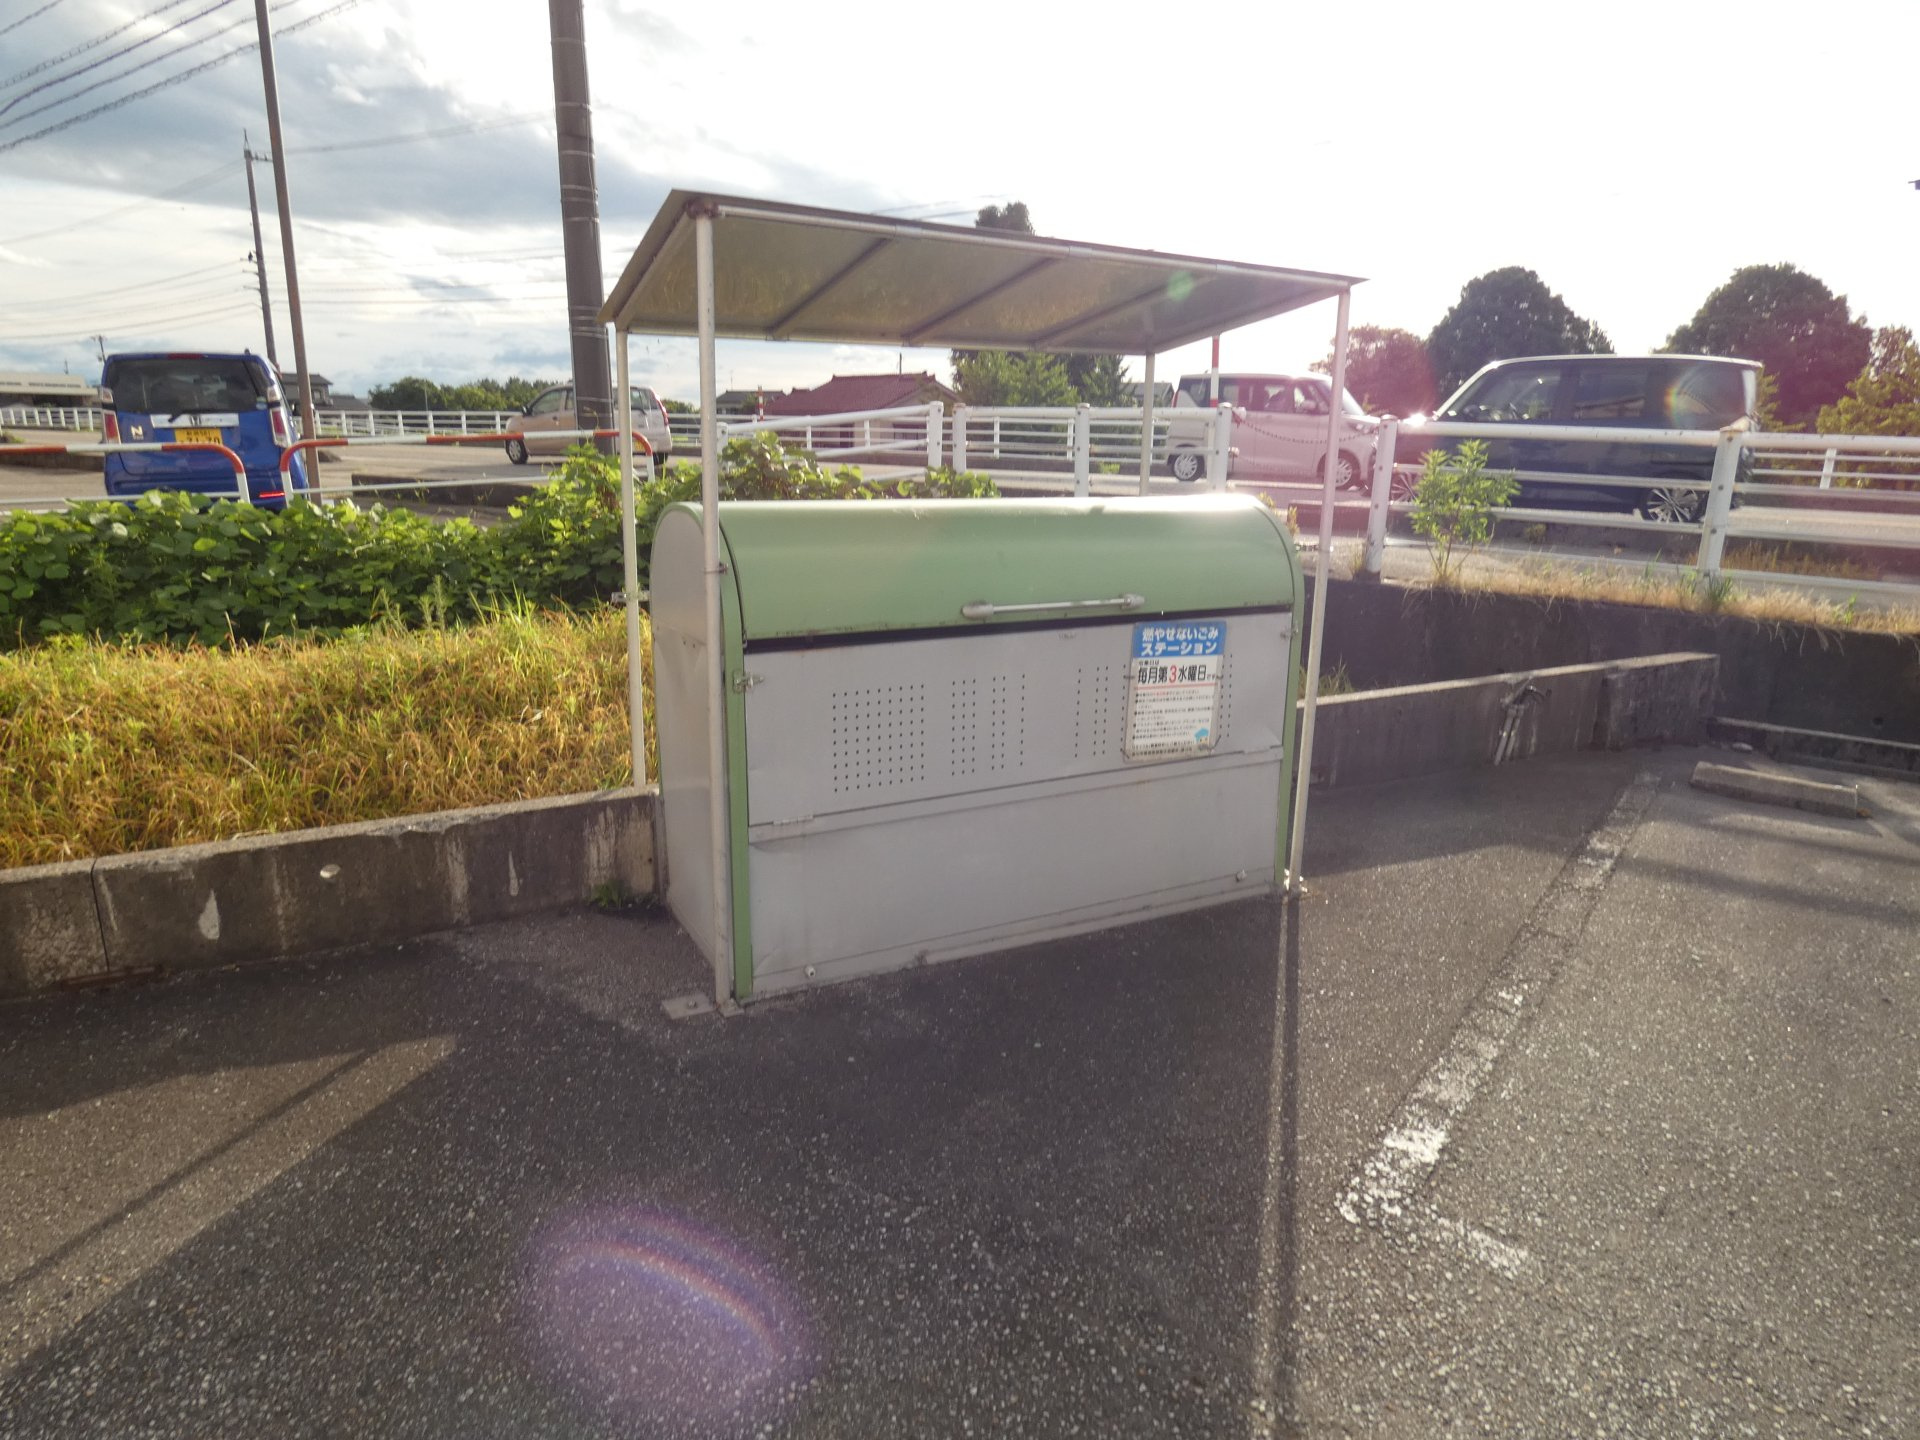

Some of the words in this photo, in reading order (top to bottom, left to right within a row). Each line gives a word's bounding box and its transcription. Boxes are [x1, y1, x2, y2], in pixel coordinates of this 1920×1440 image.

[1142, 626, 1219, 642] 燃やせないごみ
[1141, 641, 1217, 656] ステーション
